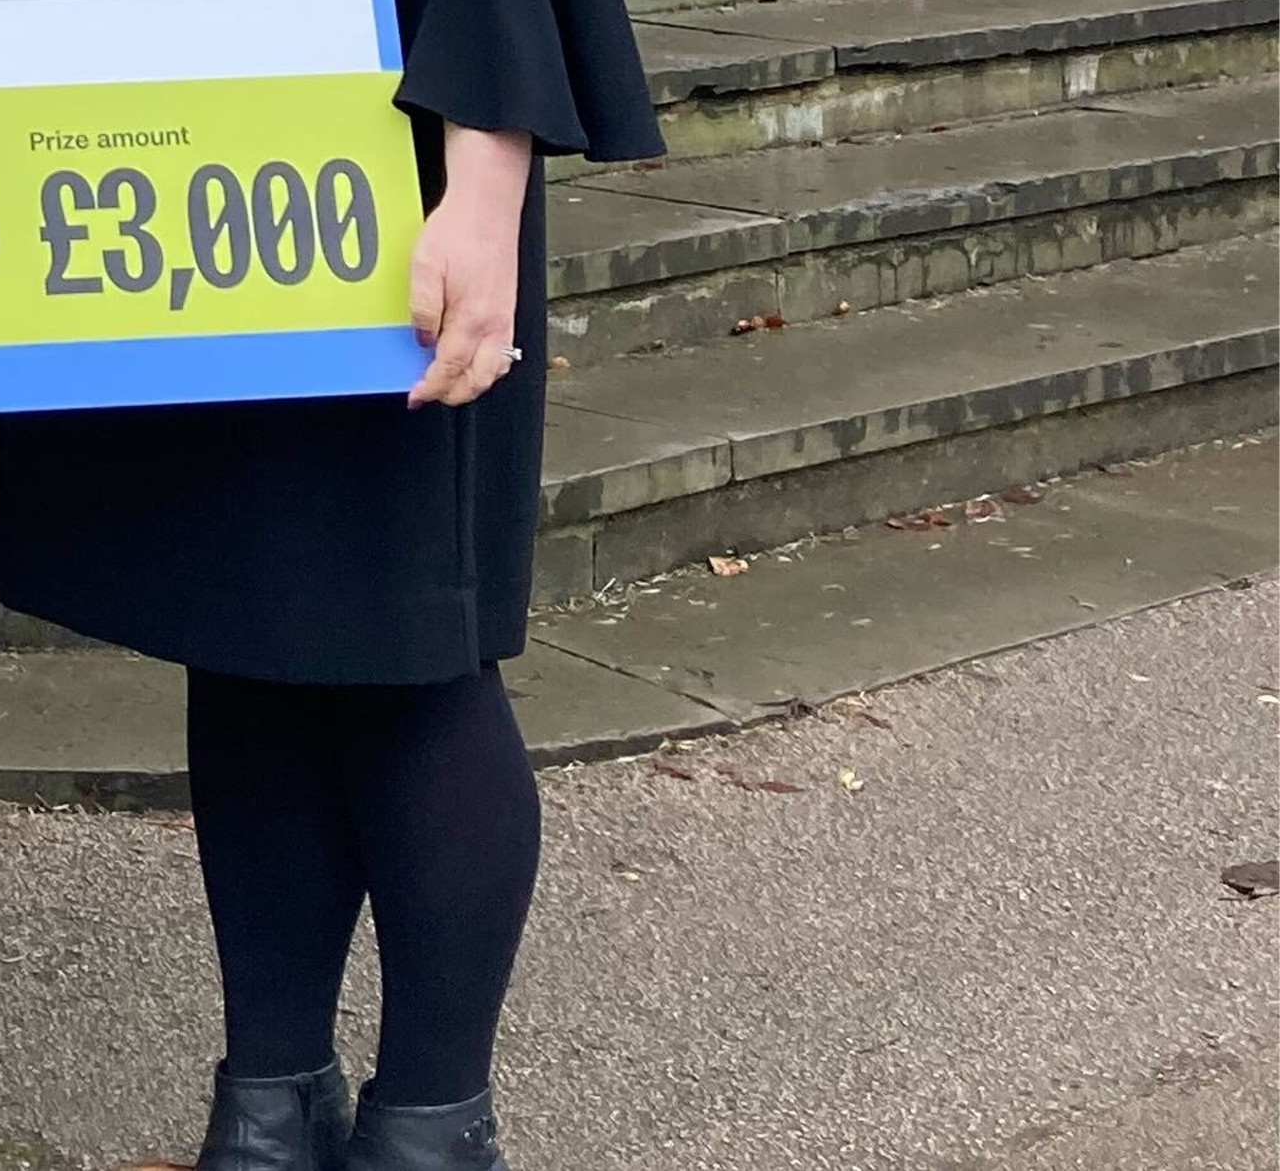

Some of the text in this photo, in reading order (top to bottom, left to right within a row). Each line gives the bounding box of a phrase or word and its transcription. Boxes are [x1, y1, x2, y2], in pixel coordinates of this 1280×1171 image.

[30, 126, 190, 151] Prize amount
[40, 158, 379, 311] £3,000
